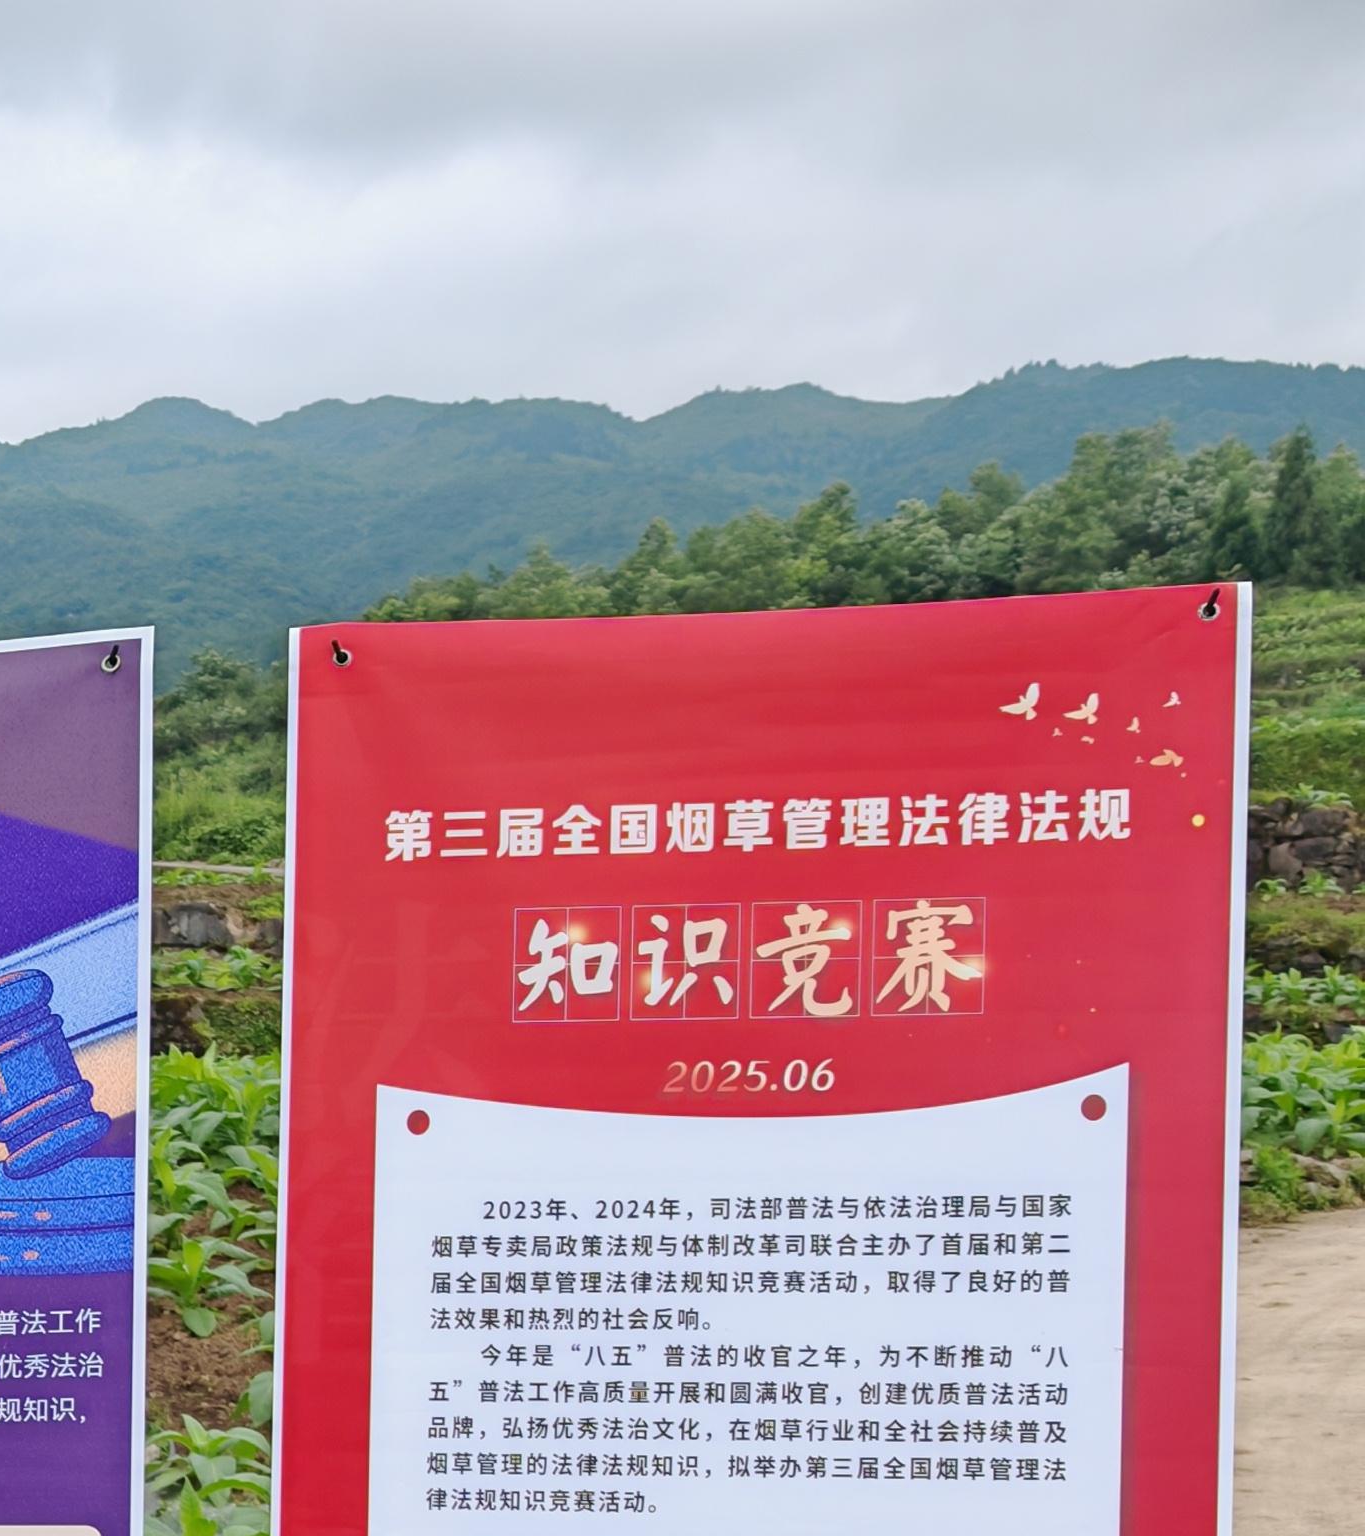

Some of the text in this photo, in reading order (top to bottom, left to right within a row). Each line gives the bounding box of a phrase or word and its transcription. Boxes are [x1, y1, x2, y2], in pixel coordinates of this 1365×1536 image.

[384, 788, 1131, 863] 第三届全国烟草管理法律法规
[517, 900, 982, 1020] 知识竞赛
[663, 1056, 836, 1094] 2025.06
[482, 1195, 1072, 1221] 2023年、2024年，司法部普法与依法治理局与国家
[431, 1232, 1072, 1258] 烟草专卖局政策法规与体制改革司联合主办了首届和第二
[430, 1269, 1070, 1296] 届全国烟草管理法律法规知识竞赛活动，取得了良好的普
[429, 1307, 716, 1331] 法效果和热烈的社会反响。
[428, 1380, 1069, 1407] 五”普法工作高质量开展和圆满收官，创建优质普法活动
[426, 1417, 1067, 1445] 品牌，弘扬优秀法治文化，在烟草行业和全社会持续普及
[426, 1453, 1067, 1481] 烟草管理的法律法规知识，拟举办第三届全国烟草管理法
[425, 1488, 661, 1513] 律法规知识竞赛活动。
